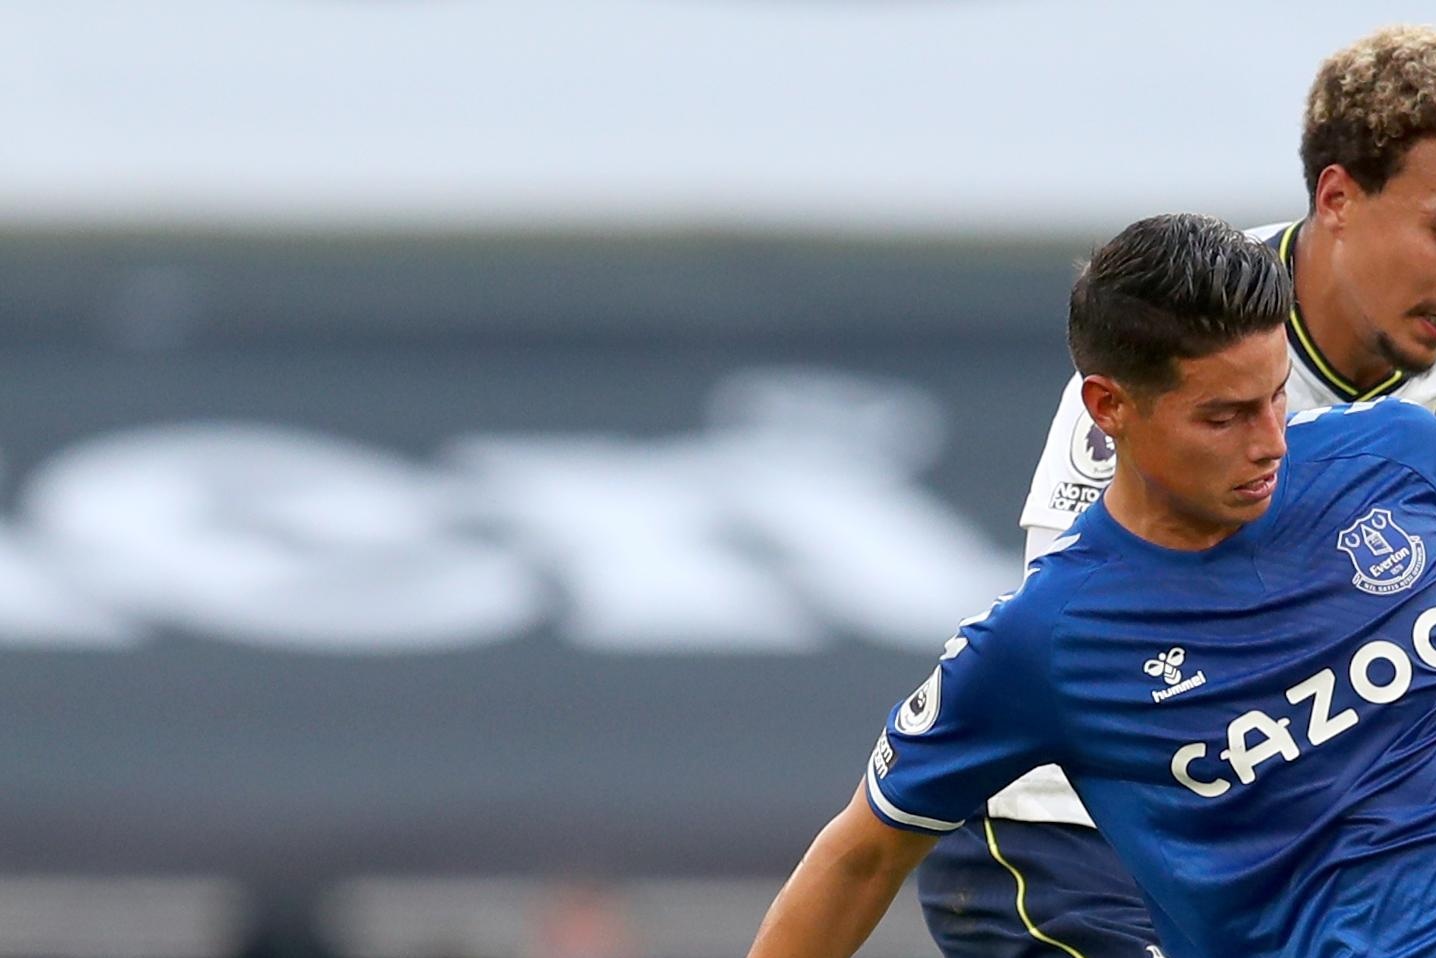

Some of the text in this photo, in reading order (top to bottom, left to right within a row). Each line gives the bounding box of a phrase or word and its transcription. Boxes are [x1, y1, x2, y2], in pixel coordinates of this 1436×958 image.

[1054, 482, 1101, 502] No ro
[1369, 547, 1410, 577] Everton
[1152, 670, 1207, 703] hummel
